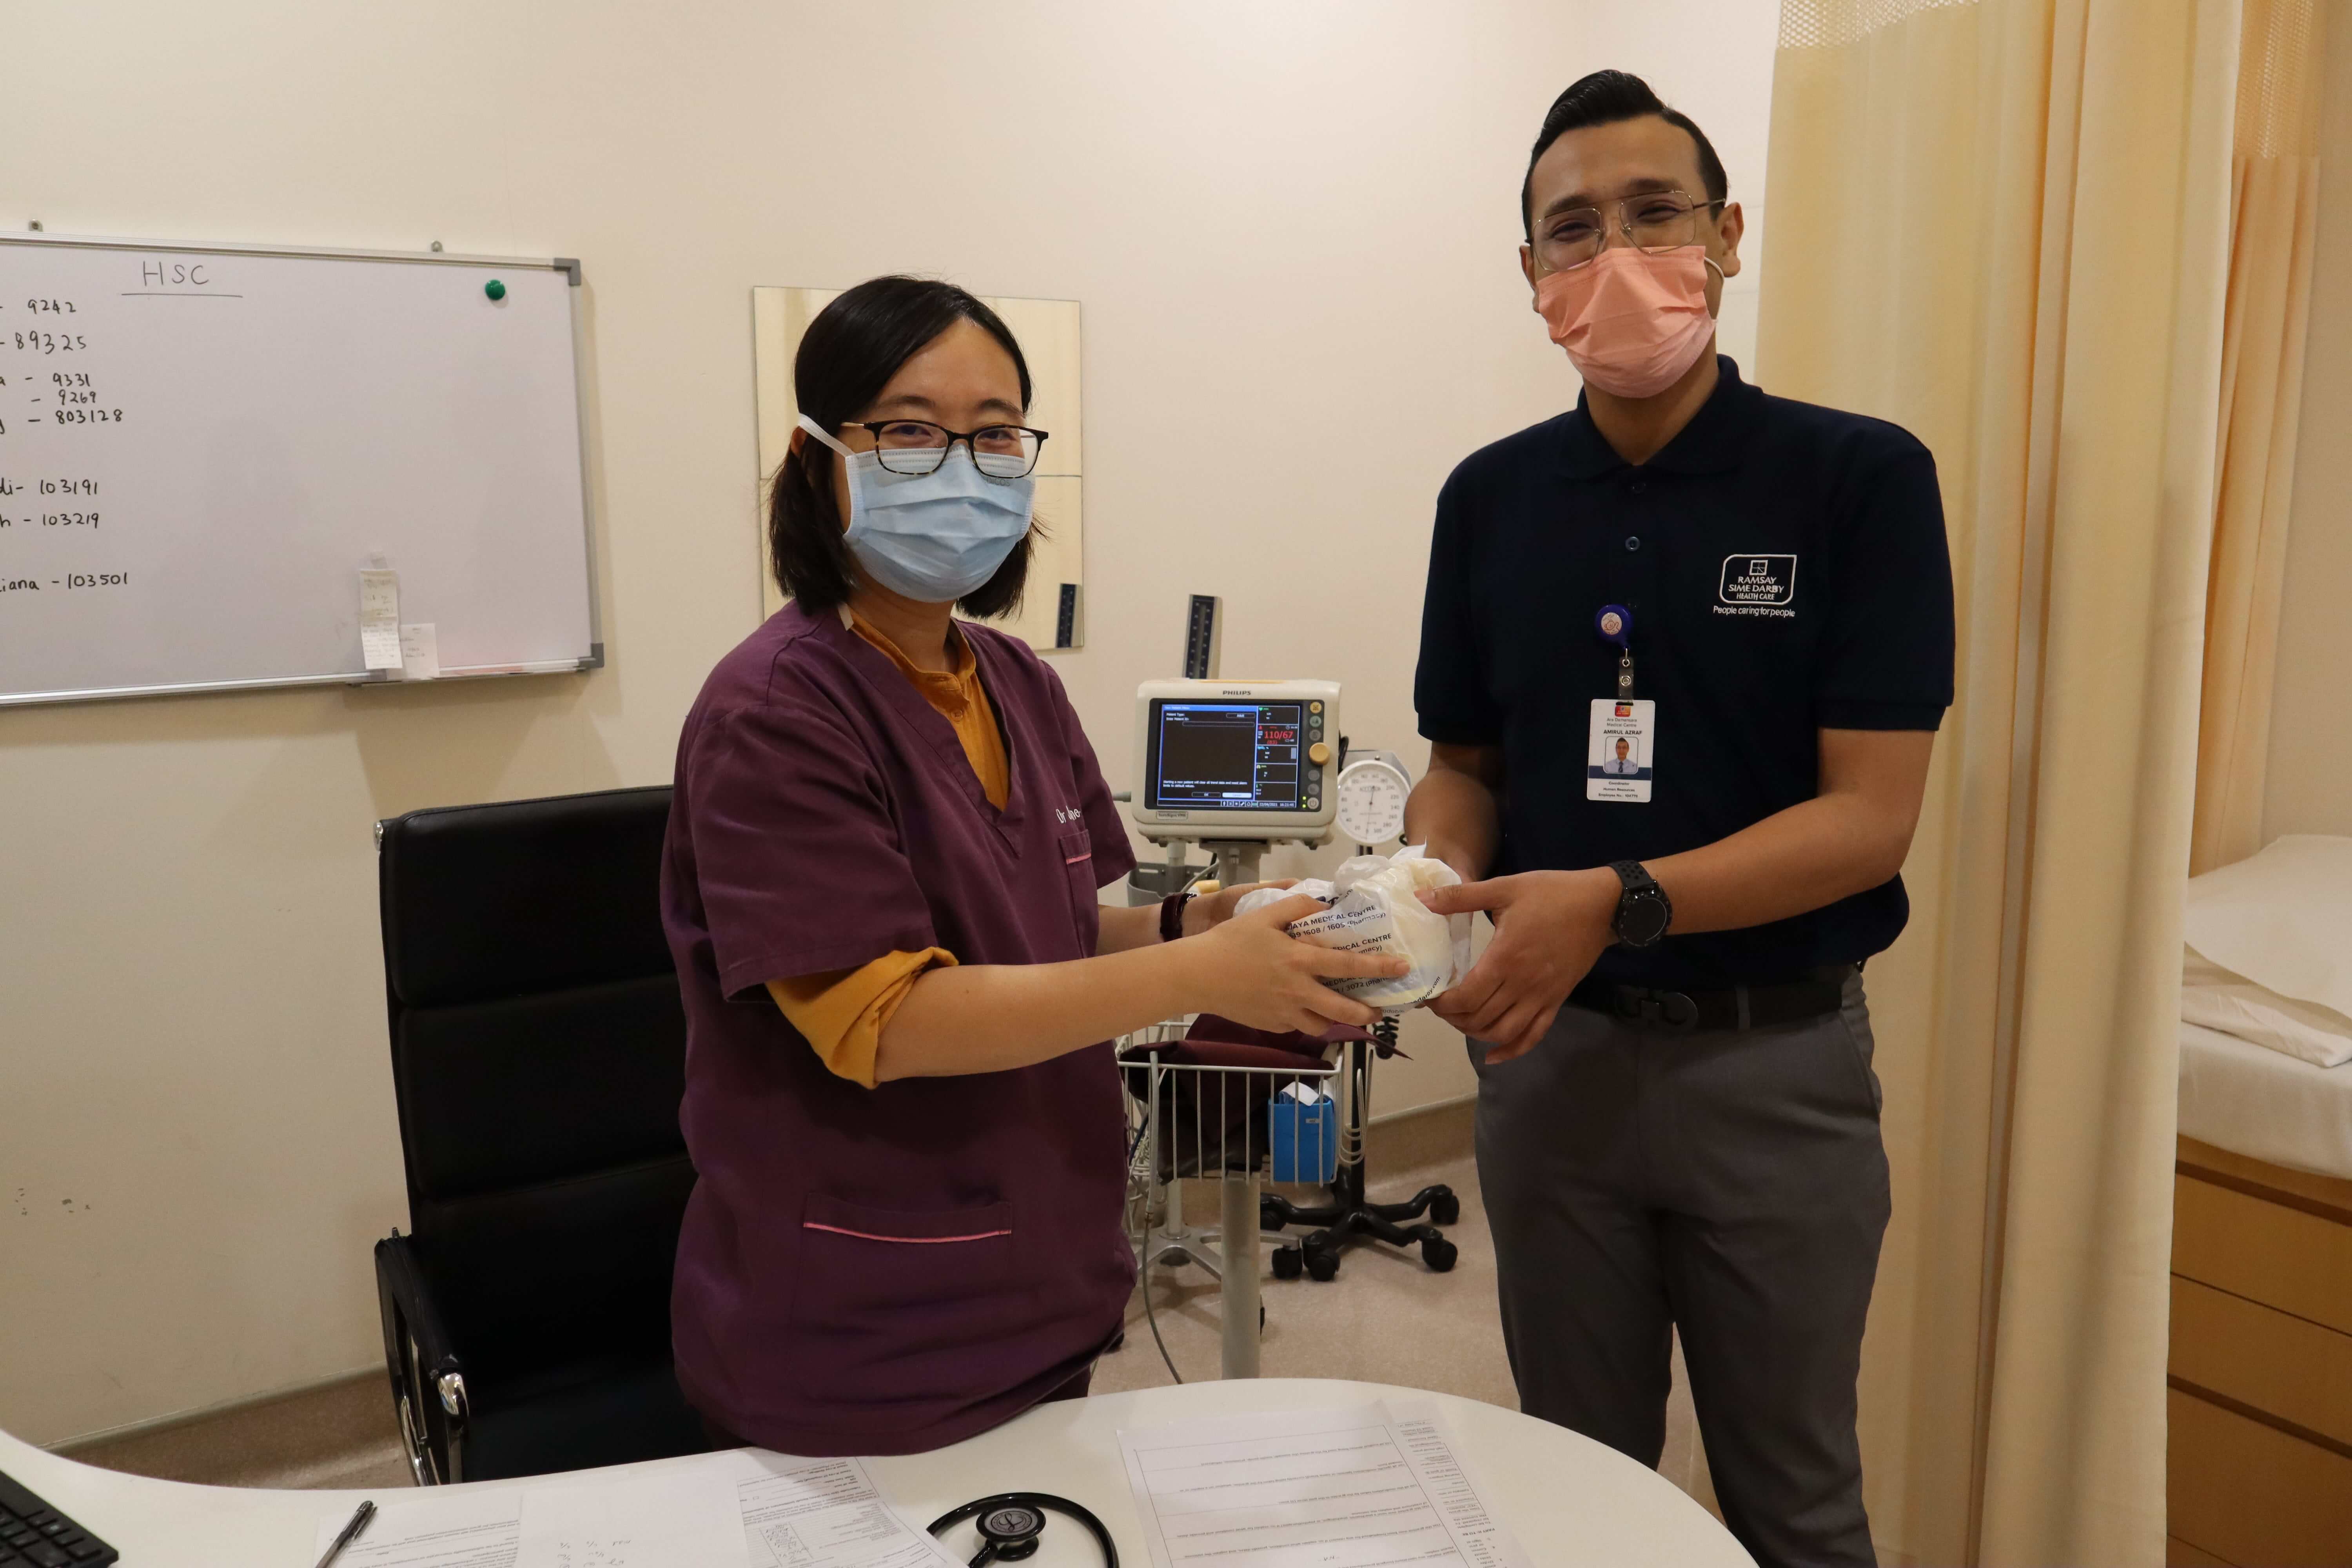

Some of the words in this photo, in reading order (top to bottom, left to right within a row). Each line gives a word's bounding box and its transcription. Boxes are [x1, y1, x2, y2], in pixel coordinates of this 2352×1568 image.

[143, 261, 209, 287] HSC
[27, 299, 76, 315] 9242
[15, 330, 87, 354] 89325
[53, 372, 91, 387] 9331
[58, 388, 97, 405] 9269
[55, 408, 123, 425] 803128
[40, 479, 98, 496] 103191
[42, 512, 99, 529] 103219
[0, 579, 40, 592] iana
[68, 572, 127, 590] 103501
[1737, 576, 1777, 584] RAMSAY
[1728, 584, 1751, 592] SIME
[1752, 585, 1784, 593] DARBY
[1713, 605, 1737, 615] People
[1738, 606, 1760, 617] caring
[1760, 607, 1769, 615] for
[1770, 608, 1795, 618] people
[1265, 731, 1293, 740] 110/67
[1362, 933, 1392, 945] CENTRE
[1346, 983, 1364, 991] 3072
